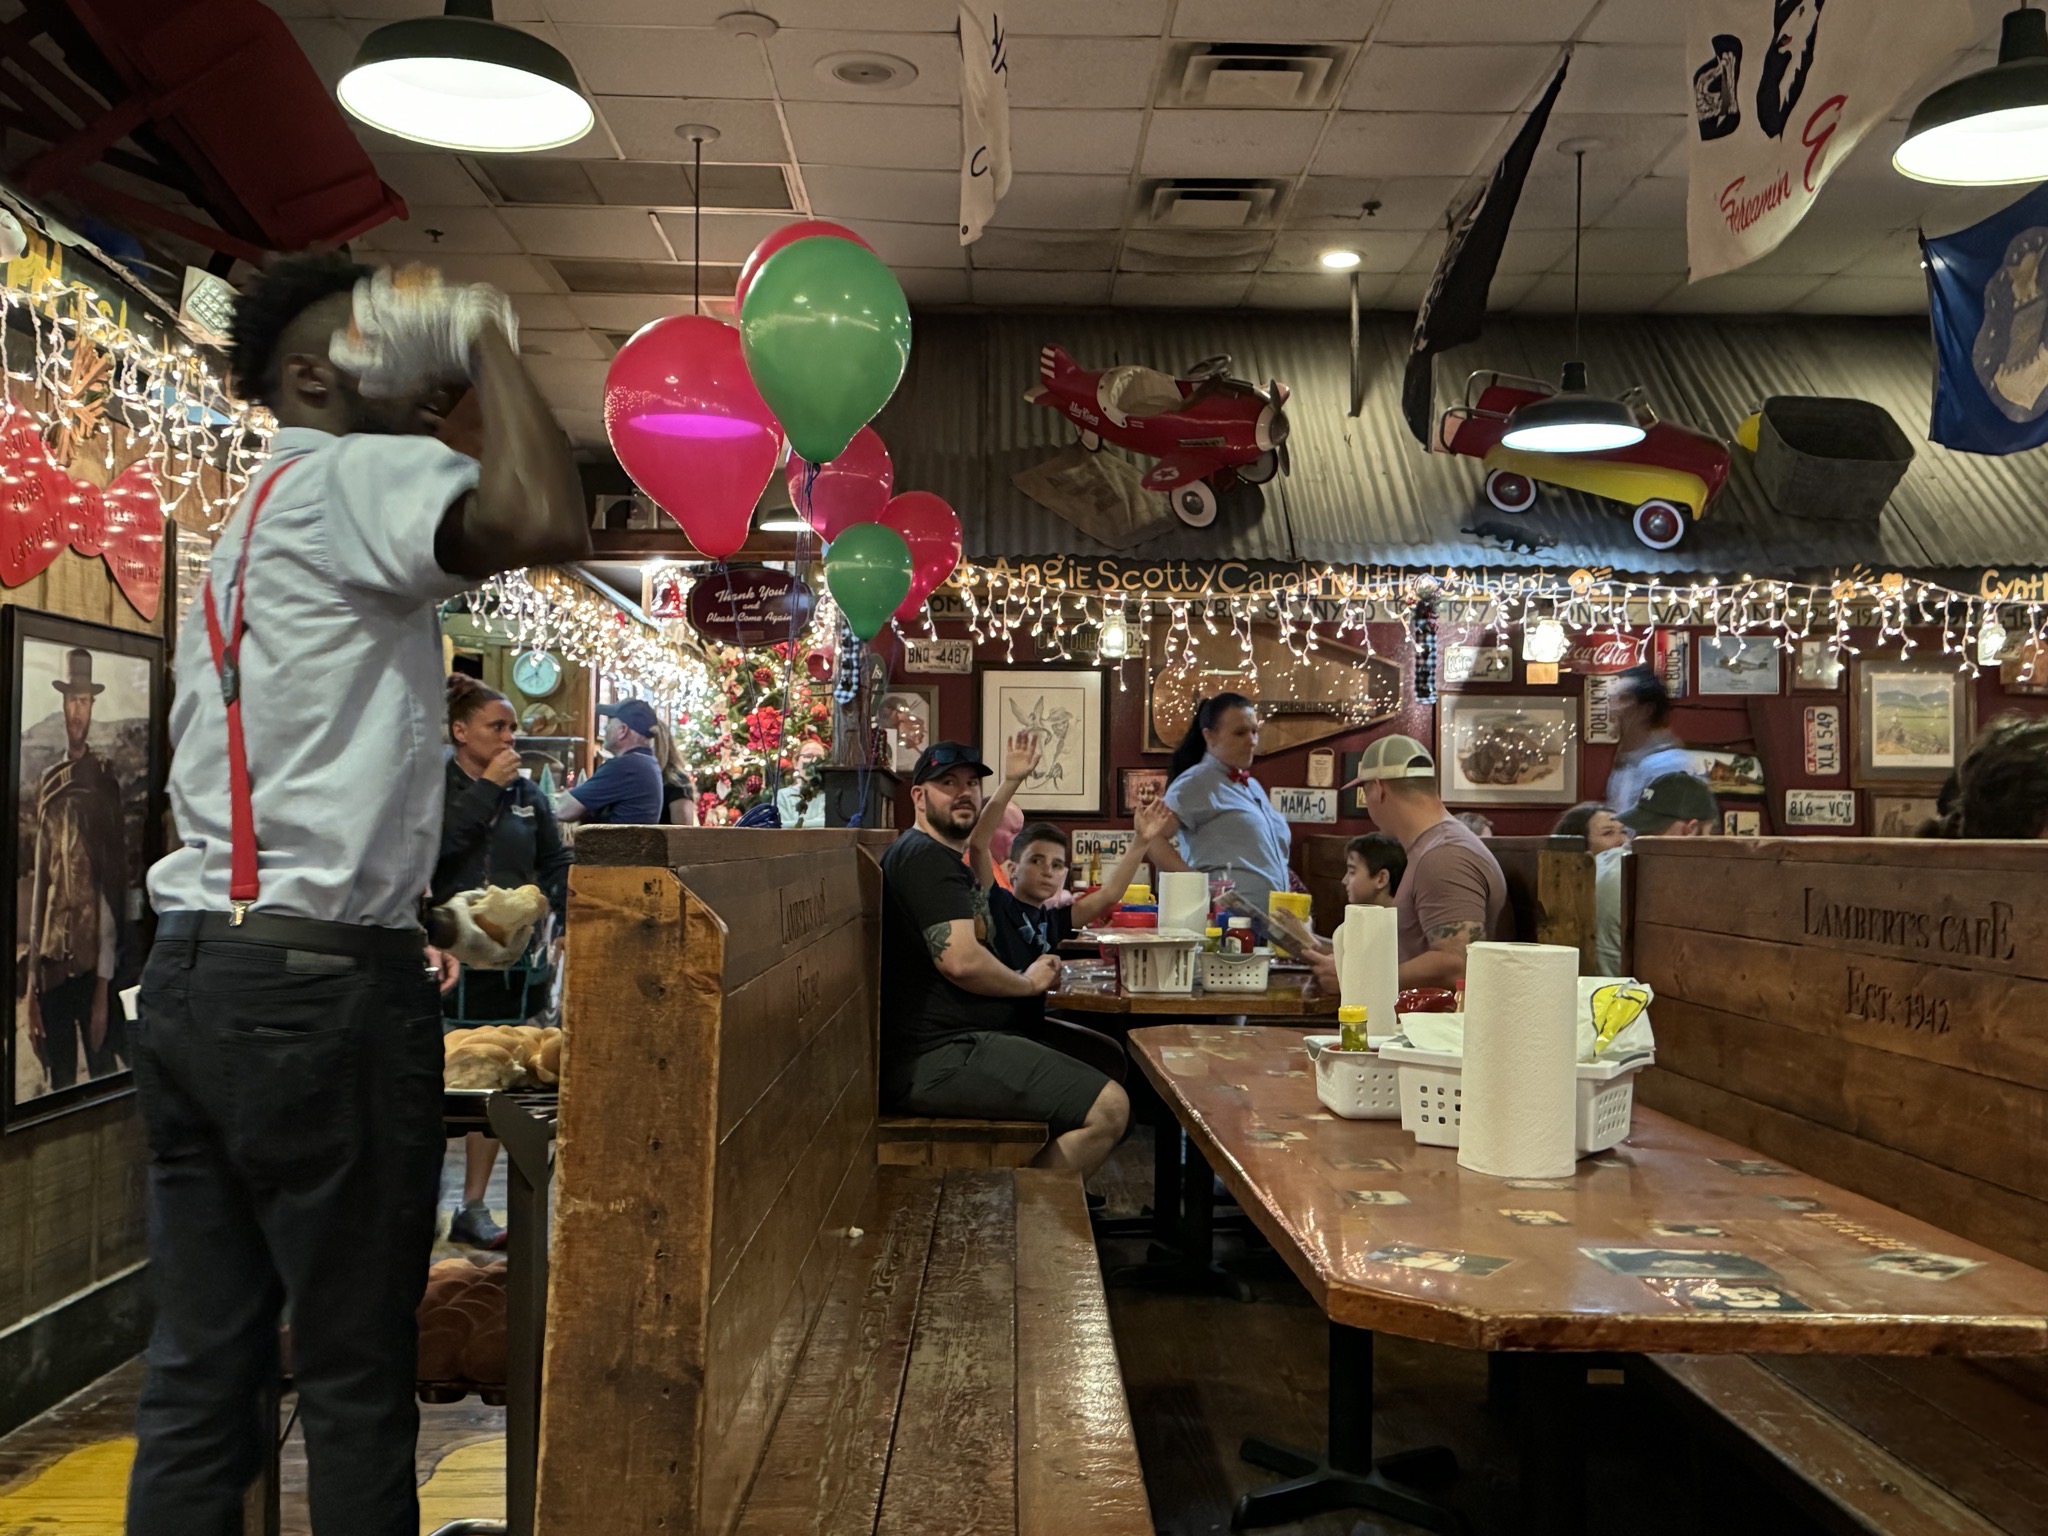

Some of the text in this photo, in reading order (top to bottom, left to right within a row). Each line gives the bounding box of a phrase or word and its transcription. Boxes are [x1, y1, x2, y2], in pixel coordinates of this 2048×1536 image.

[1097, 560, 1217, 593] Scotty
[715, 584, 788, 603] Thank You!
[742, 601, 760, 610] and
[706, 612, 735, 623] Please
[737, 613, 762, 622] Come
[940, 647, 970, 665] 4487
[1816, 711, 1834, 739] 549
[1817, 743, 1835, 770] XLA
[1803, 887, 2016, 961] LAMBERT'S CAFE
[1903, 993, 1950, 1034] 1942
